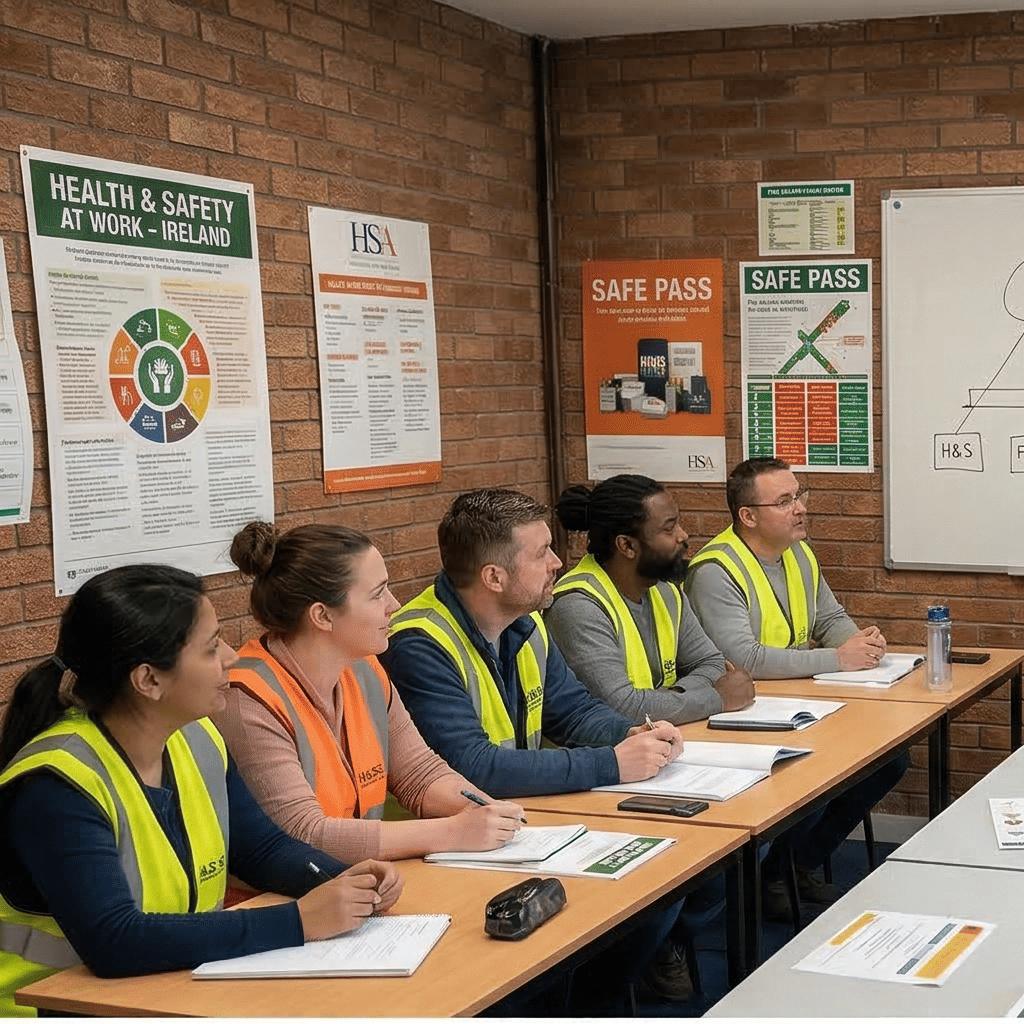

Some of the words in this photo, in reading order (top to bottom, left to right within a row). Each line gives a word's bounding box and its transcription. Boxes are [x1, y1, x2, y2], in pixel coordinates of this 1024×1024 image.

[50, 172, 136, 211] HEALTH
[141, 187, 157, 214] &
[161, 190, 235, 224] SAFETY
[60, 207, 84, 231] AT
[89, 210, 144, 239] WORK
[161, 219, 231, 249] IRELAND
[350, 221, 398, 257] HSA
[591, 277, 648, 302] SAFE
[655, 276, 713, 301] PASS
[751, 269, 802, 291] SAFE
[808, 267, 861, 289] PASS
[688, 455, 714, 469] HSA
[941, 442, 973, 460] H&S
